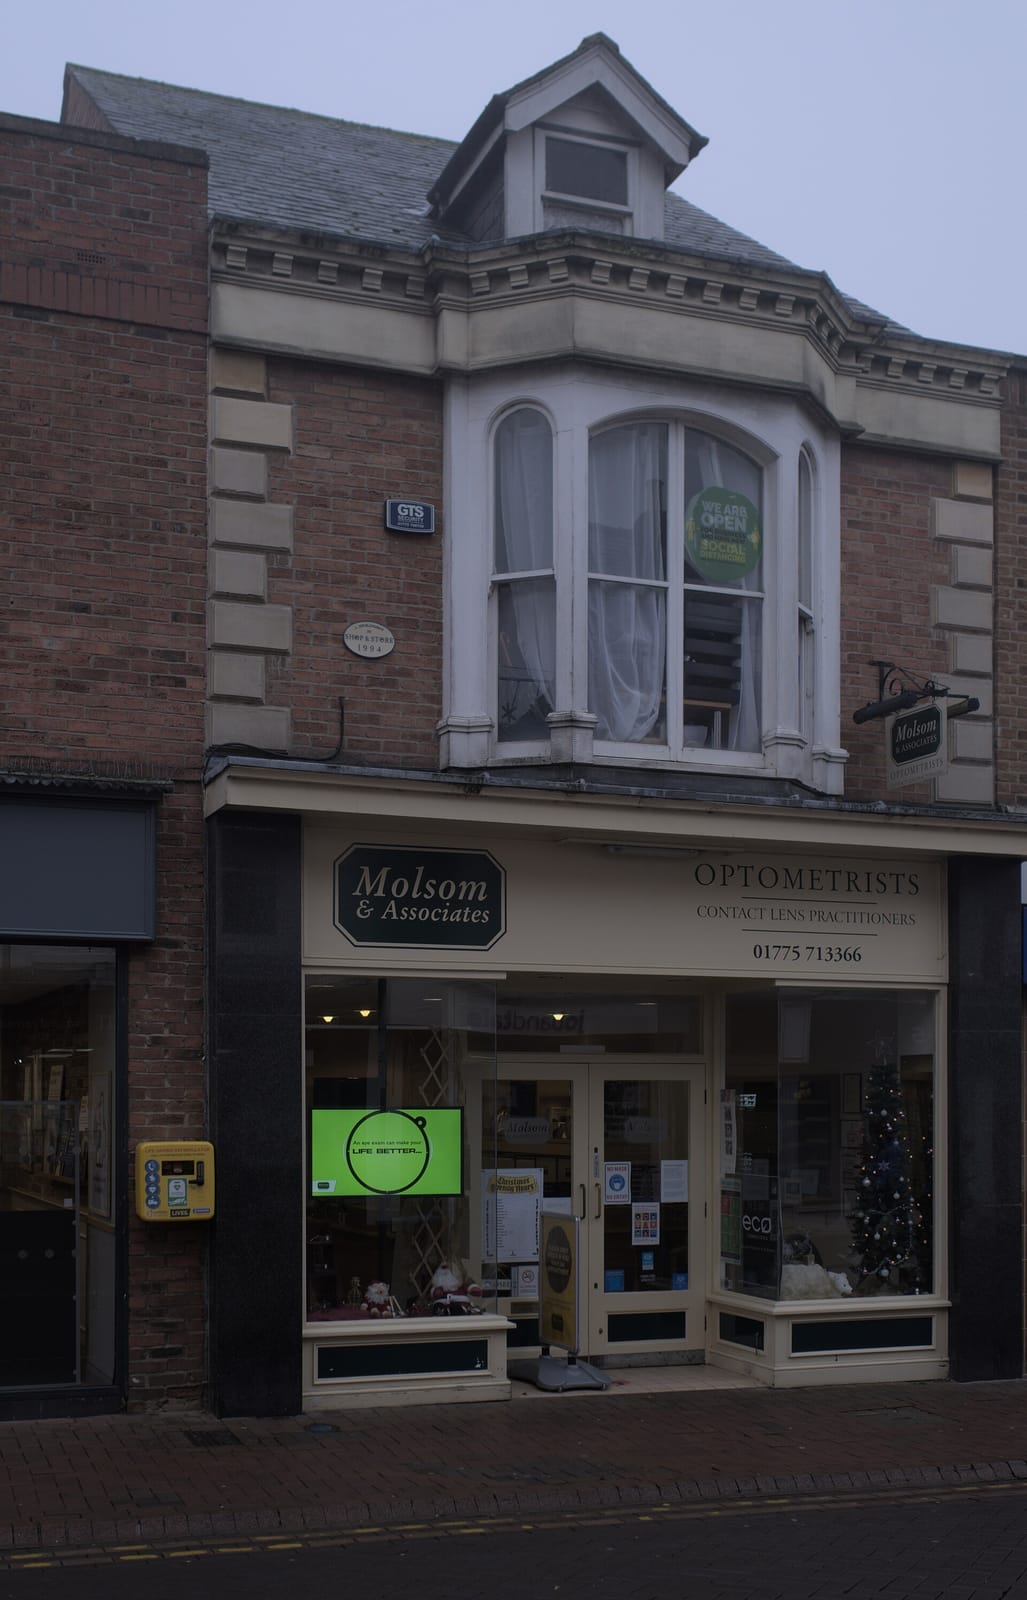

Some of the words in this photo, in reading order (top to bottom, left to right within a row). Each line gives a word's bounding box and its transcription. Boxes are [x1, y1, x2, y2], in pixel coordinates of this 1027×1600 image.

[397, 503, 425, 518] GTS
[702, 500, 721, 514] WE
[701, 512, 747, 533] OPEN
[701, 539, 746, 555] SOCIAL
[358, 644, 382, 652] 1994
[896, 719, 937, 743] Molsom
[352, 865, 488, 902] Molsom
[694, 863, 920, 896] OPTOMETRISTS
[356, 899, 375, 919] &
[381, 899, 490, 924] Associates
[697, 905, 766, 920] CONTACT
[771, 908, 805, 922] LENS
[809, 910, 916, 926] PRACTITIONERS
[753, 944, 800, 961] 01775
[805, 946, 862, 962] 713366
[742, 1214, 772, 1233] eco
